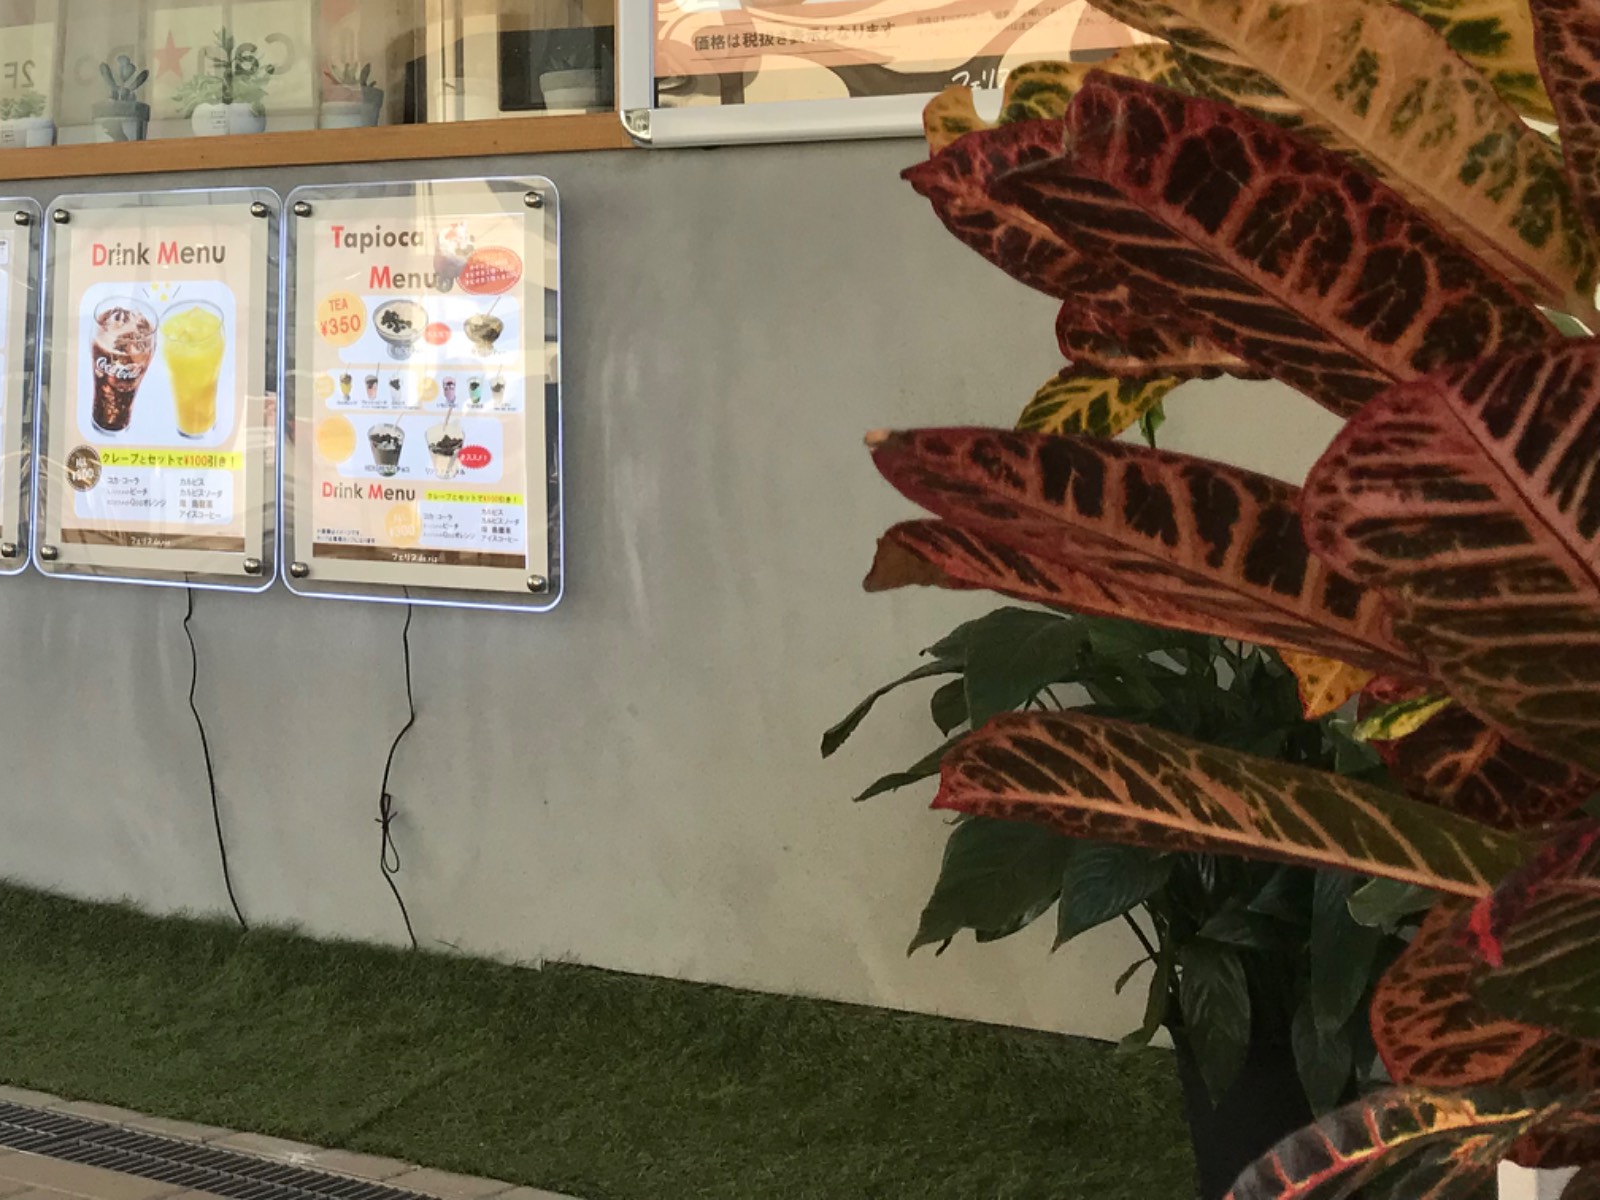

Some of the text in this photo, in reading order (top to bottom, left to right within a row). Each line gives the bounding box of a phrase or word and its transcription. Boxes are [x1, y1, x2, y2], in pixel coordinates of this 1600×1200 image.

[331, 225, 425, 253] Tapioca
[91, 240, 227, 267] Drink Menu
[369, 265, 438, 290] Menu
[328, 297, 349, 312] TEA
[320, 314, 362, 337] ¥350
[321, 481, 416, 501] Drink Menu
